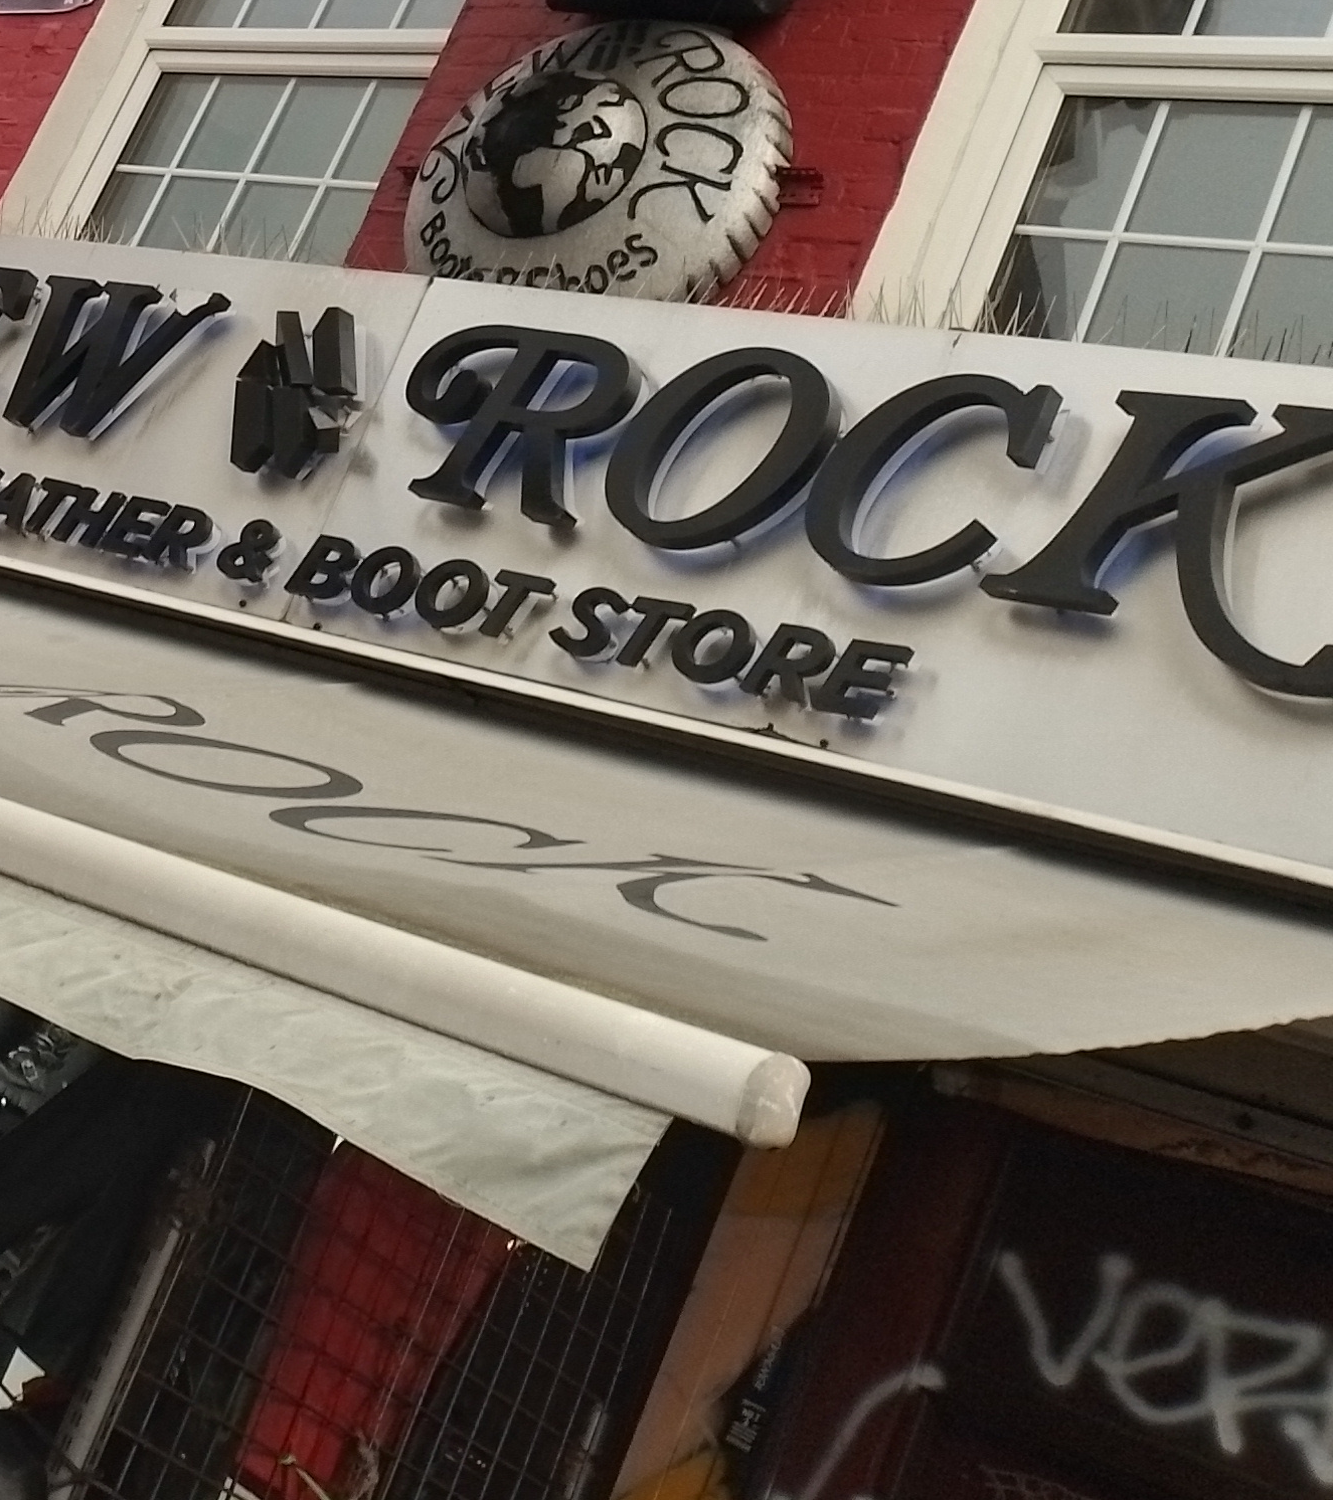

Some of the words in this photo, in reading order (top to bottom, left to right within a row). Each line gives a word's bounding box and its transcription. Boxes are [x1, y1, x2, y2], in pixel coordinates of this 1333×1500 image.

[627, 29, 750, 225] ROCK
[405, 322, 1333, 700] ROCK
[215, 518, 283, 584] &
[284, 534, 559, 642] BOOT
[548, 586, 919, 722] STORE
